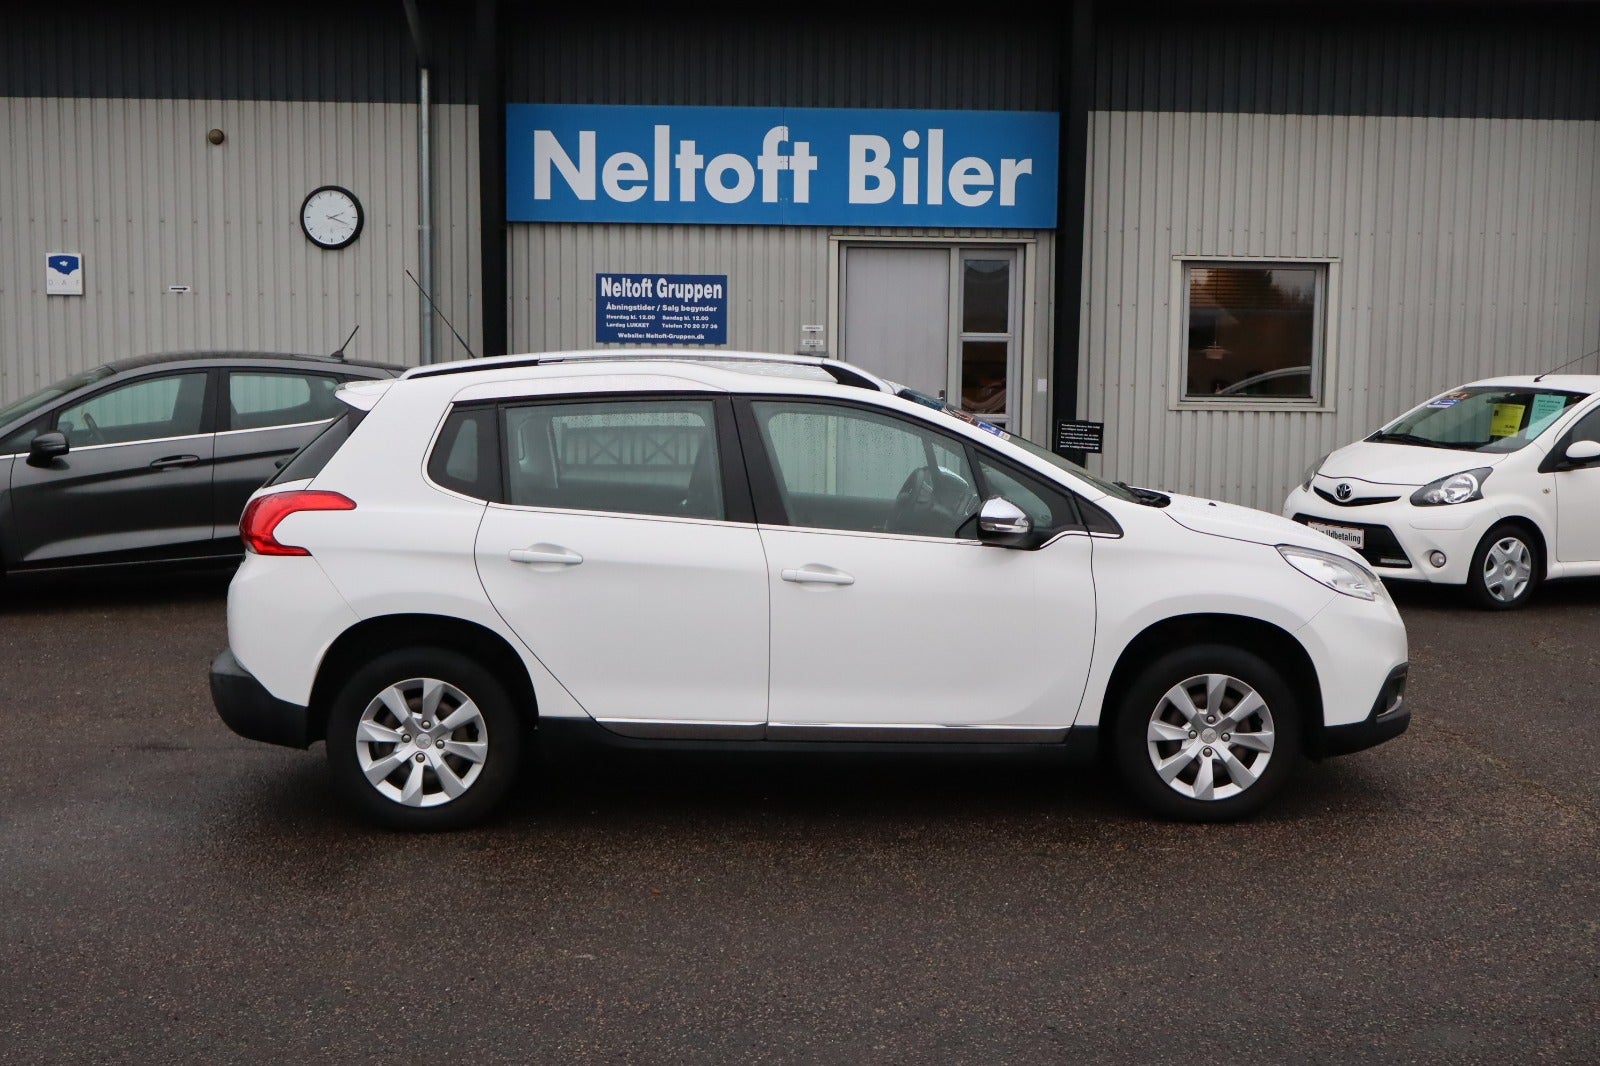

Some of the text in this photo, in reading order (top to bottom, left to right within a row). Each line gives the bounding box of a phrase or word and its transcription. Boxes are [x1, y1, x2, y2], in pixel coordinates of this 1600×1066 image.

[533, 124, 1033, 207] Neltoft Biler
[601, 277, 722, 302] Neltoft Gruppen
[606, 301, 656, 311] Åbningstider
[662, 304, 679, 312] Salg
[680, 304, 718, 312] begynder
